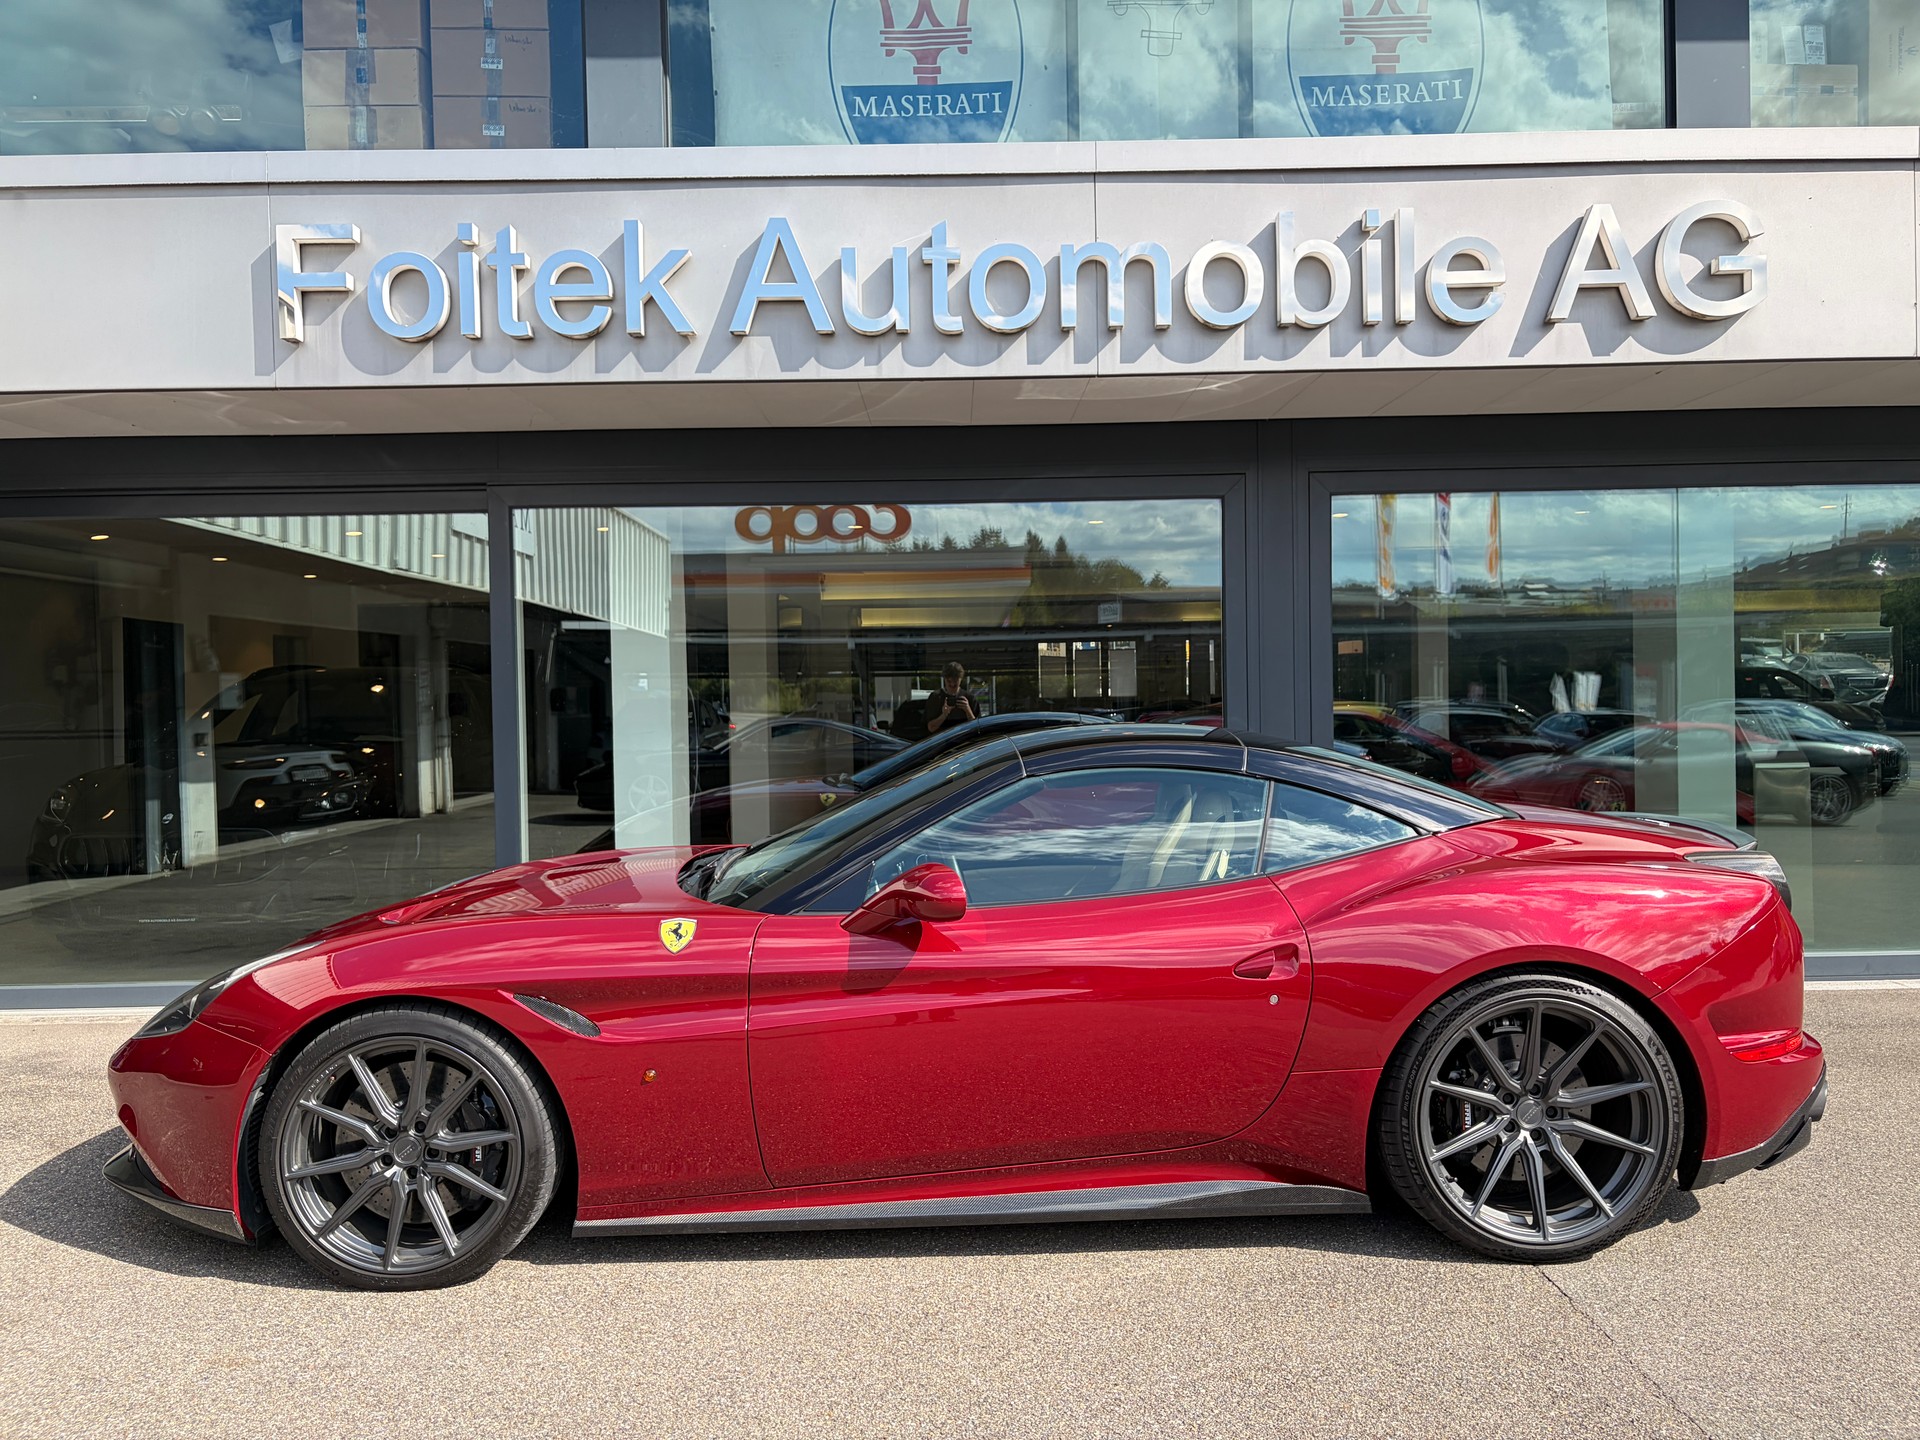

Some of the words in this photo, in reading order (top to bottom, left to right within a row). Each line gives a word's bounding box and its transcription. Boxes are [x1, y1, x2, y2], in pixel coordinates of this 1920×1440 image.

[853, 91, 1003, 119] MASERATI
[1310, 78, 1464, 108] MASERATI
[275, 219, 698, 344] Foitek
[729, 207, 1507, 336] Automobile
[1545, 199, 1768, 321] AG
[1403, 1092, 1411, 1111] PILOT
[1657, 1054, 1680, 1122] MICHELIN
[1401, 1117, 1423, 1185] MICHELIN
